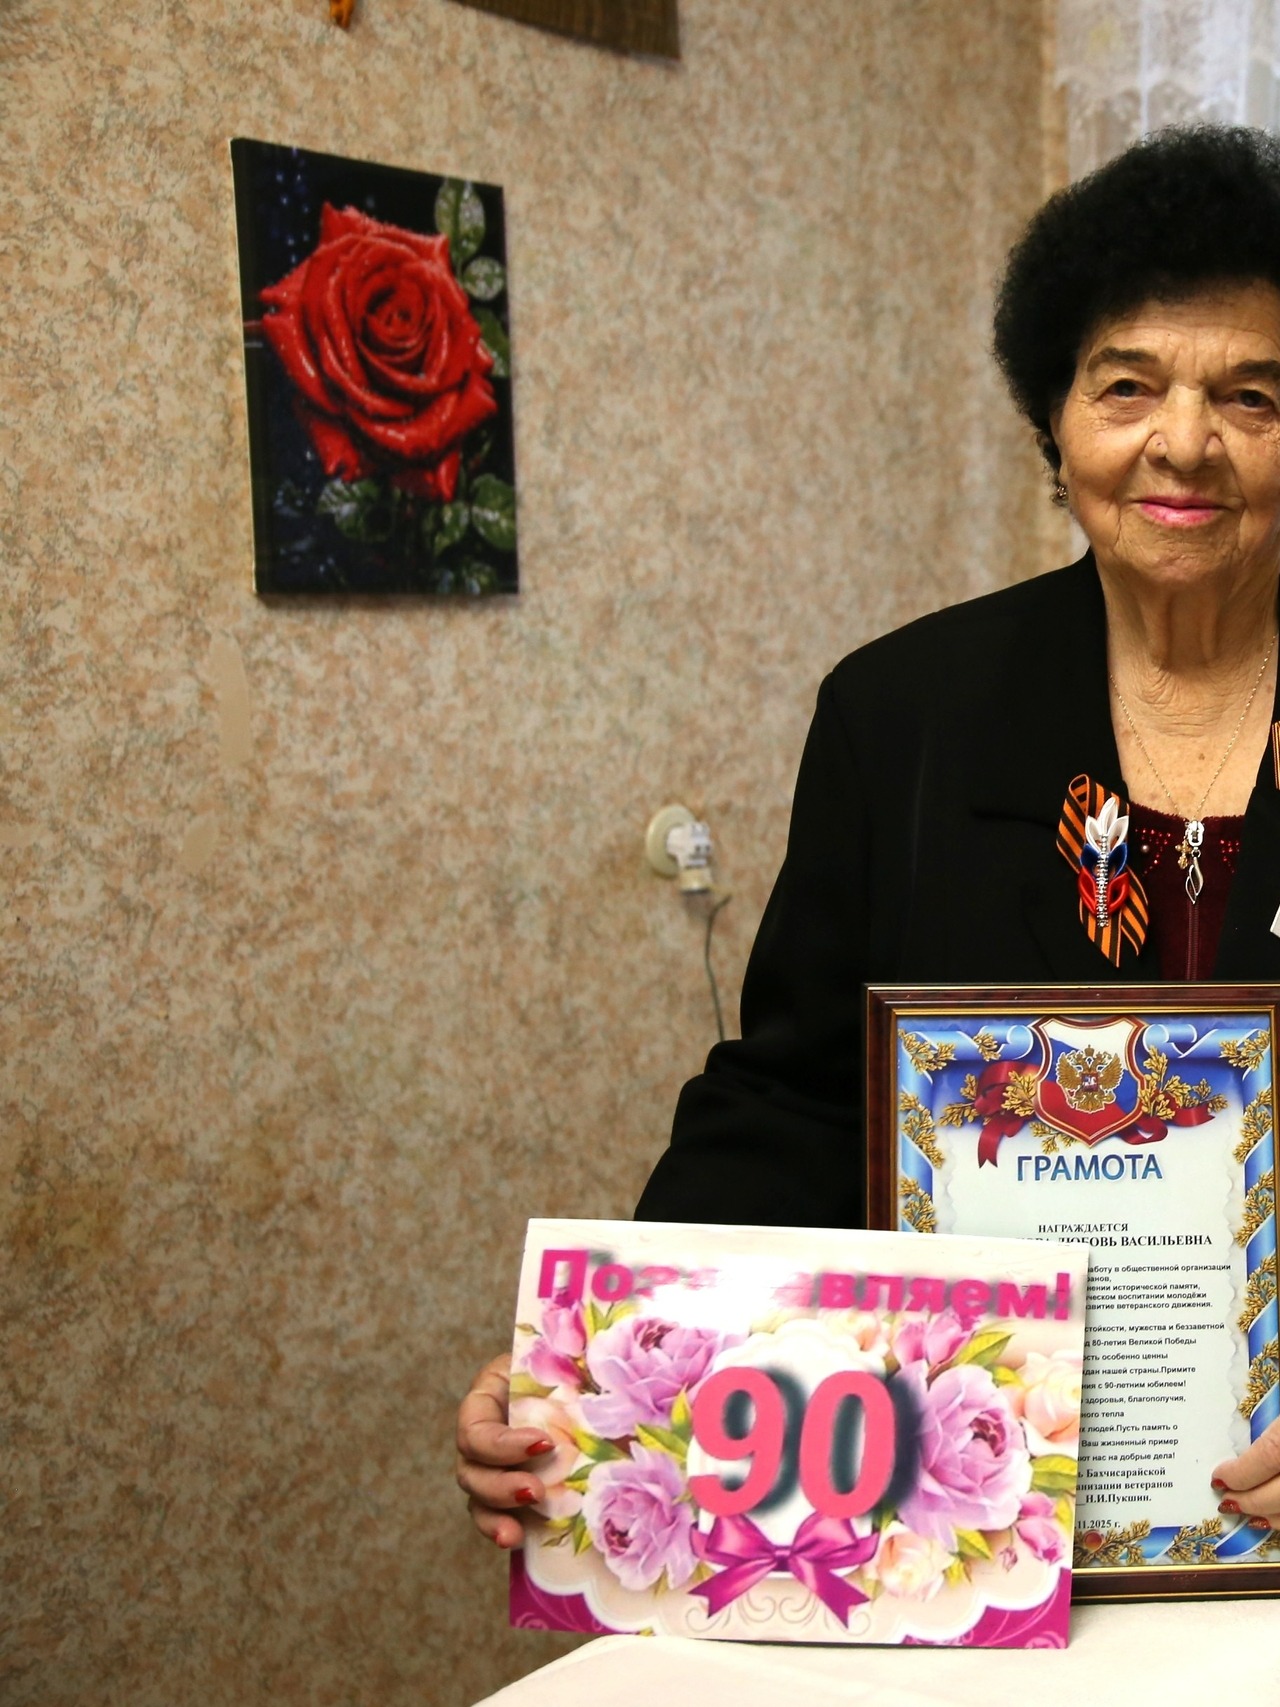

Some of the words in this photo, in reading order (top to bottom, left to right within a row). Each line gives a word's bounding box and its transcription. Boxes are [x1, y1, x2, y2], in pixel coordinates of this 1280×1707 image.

[1017, 1153, 1163, 1181] ГРАМОТА
[1038, 1224, 1129, 1234] НАГРАЖДАЕТСЯ
[1121, 1235, 1213, 1247] ВАСИЛЬЕВНА
[1122, 1265, 1180, 1273] общественной
[1181, 1265, 1232, 1273] организации
[537, 1249, 1071, 1321] Повляем!
[1113, 1284, 1168, 1293] исторической
[1170, 1283, 1201, 1291] памяти,
[1166, 1292, 1208, 1300] молодёжи
[1117, 1302, 1170, 1311] ветеранского
[1171, 1301, 1213, 1310] движения.
[1129, 1325, 1167, 1334] мужества
[1175, 1323, 1225, 1331] беззаветной
[1092, 1339, 1127, 1347] 80-летия
[1129, 1338, 1163, 1346] Великой
[1165, 1338, 1197, 1346] Победы
[1102, 1353, 1141, 1361] особенно
[1142, 1353, 1169, 1361] ценны
[1102, 1367, 1128, 1375] нашей
[1147, 1380, 1187, 1389] юбилеем!
[1086, 1397, 1127, 1406] здоровья,
[1128, 1395, 1186, 1404] благополучия,
[688, 1366, 896, 1518] 90
[1082, 1440, 1099, 1448] Ваш
[1101, 1439, 1147, 1447] жизненный
[1149, 1439, 1179, 1448] пример
[1120, 1453, 1152, 1462] добрые
[1153, 1452, 1176, 1461] дела!
[1086, 1468, 1166, 1480] Бахчисарайской
[1125, 1482, 1174, 1491] ветеранов
